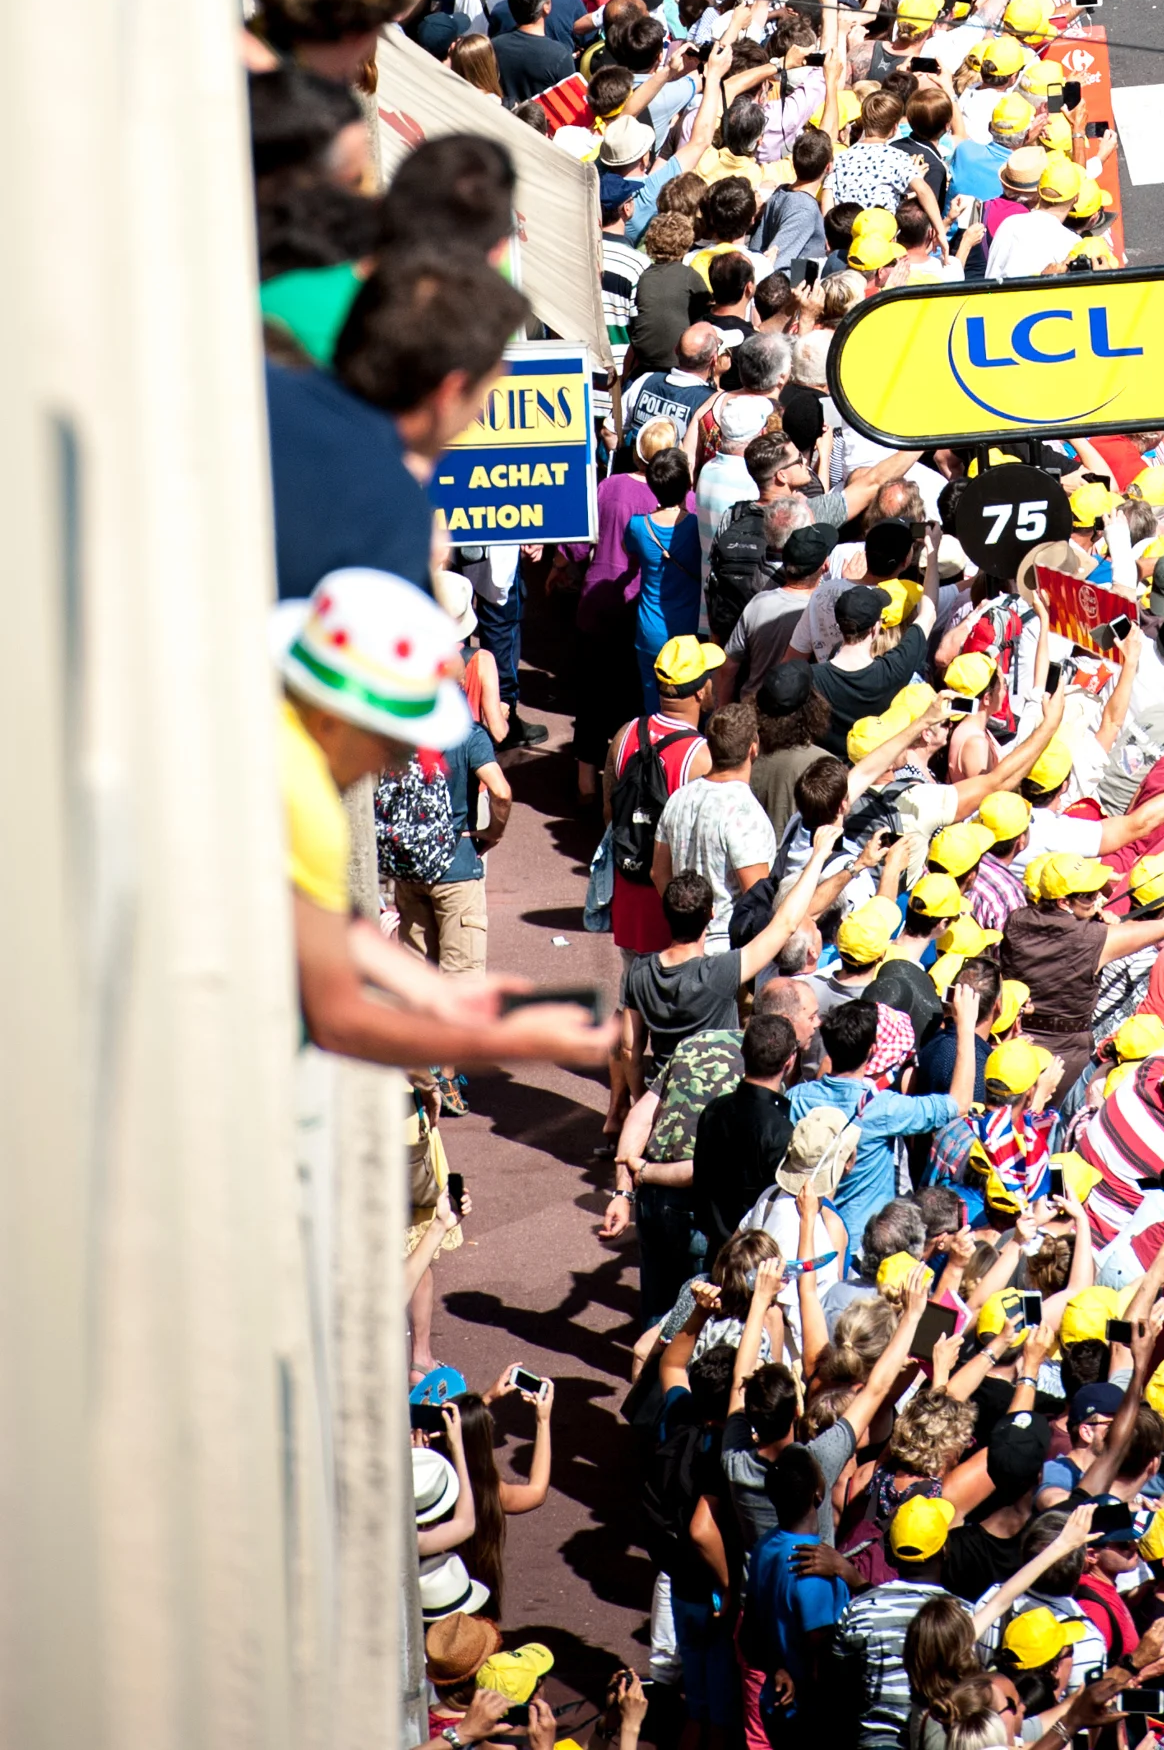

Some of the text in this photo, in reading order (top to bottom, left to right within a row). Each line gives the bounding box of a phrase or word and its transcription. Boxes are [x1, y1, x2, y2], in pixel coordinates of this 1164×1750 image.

[966, 307, 1144, 368] LCL
[465, 386, 572, 432] NCIENS
[638, 394, 687, 420] POLICE
[468, 463, 569, 489] ACHAT
[982, 500, 1048, 545] 75
